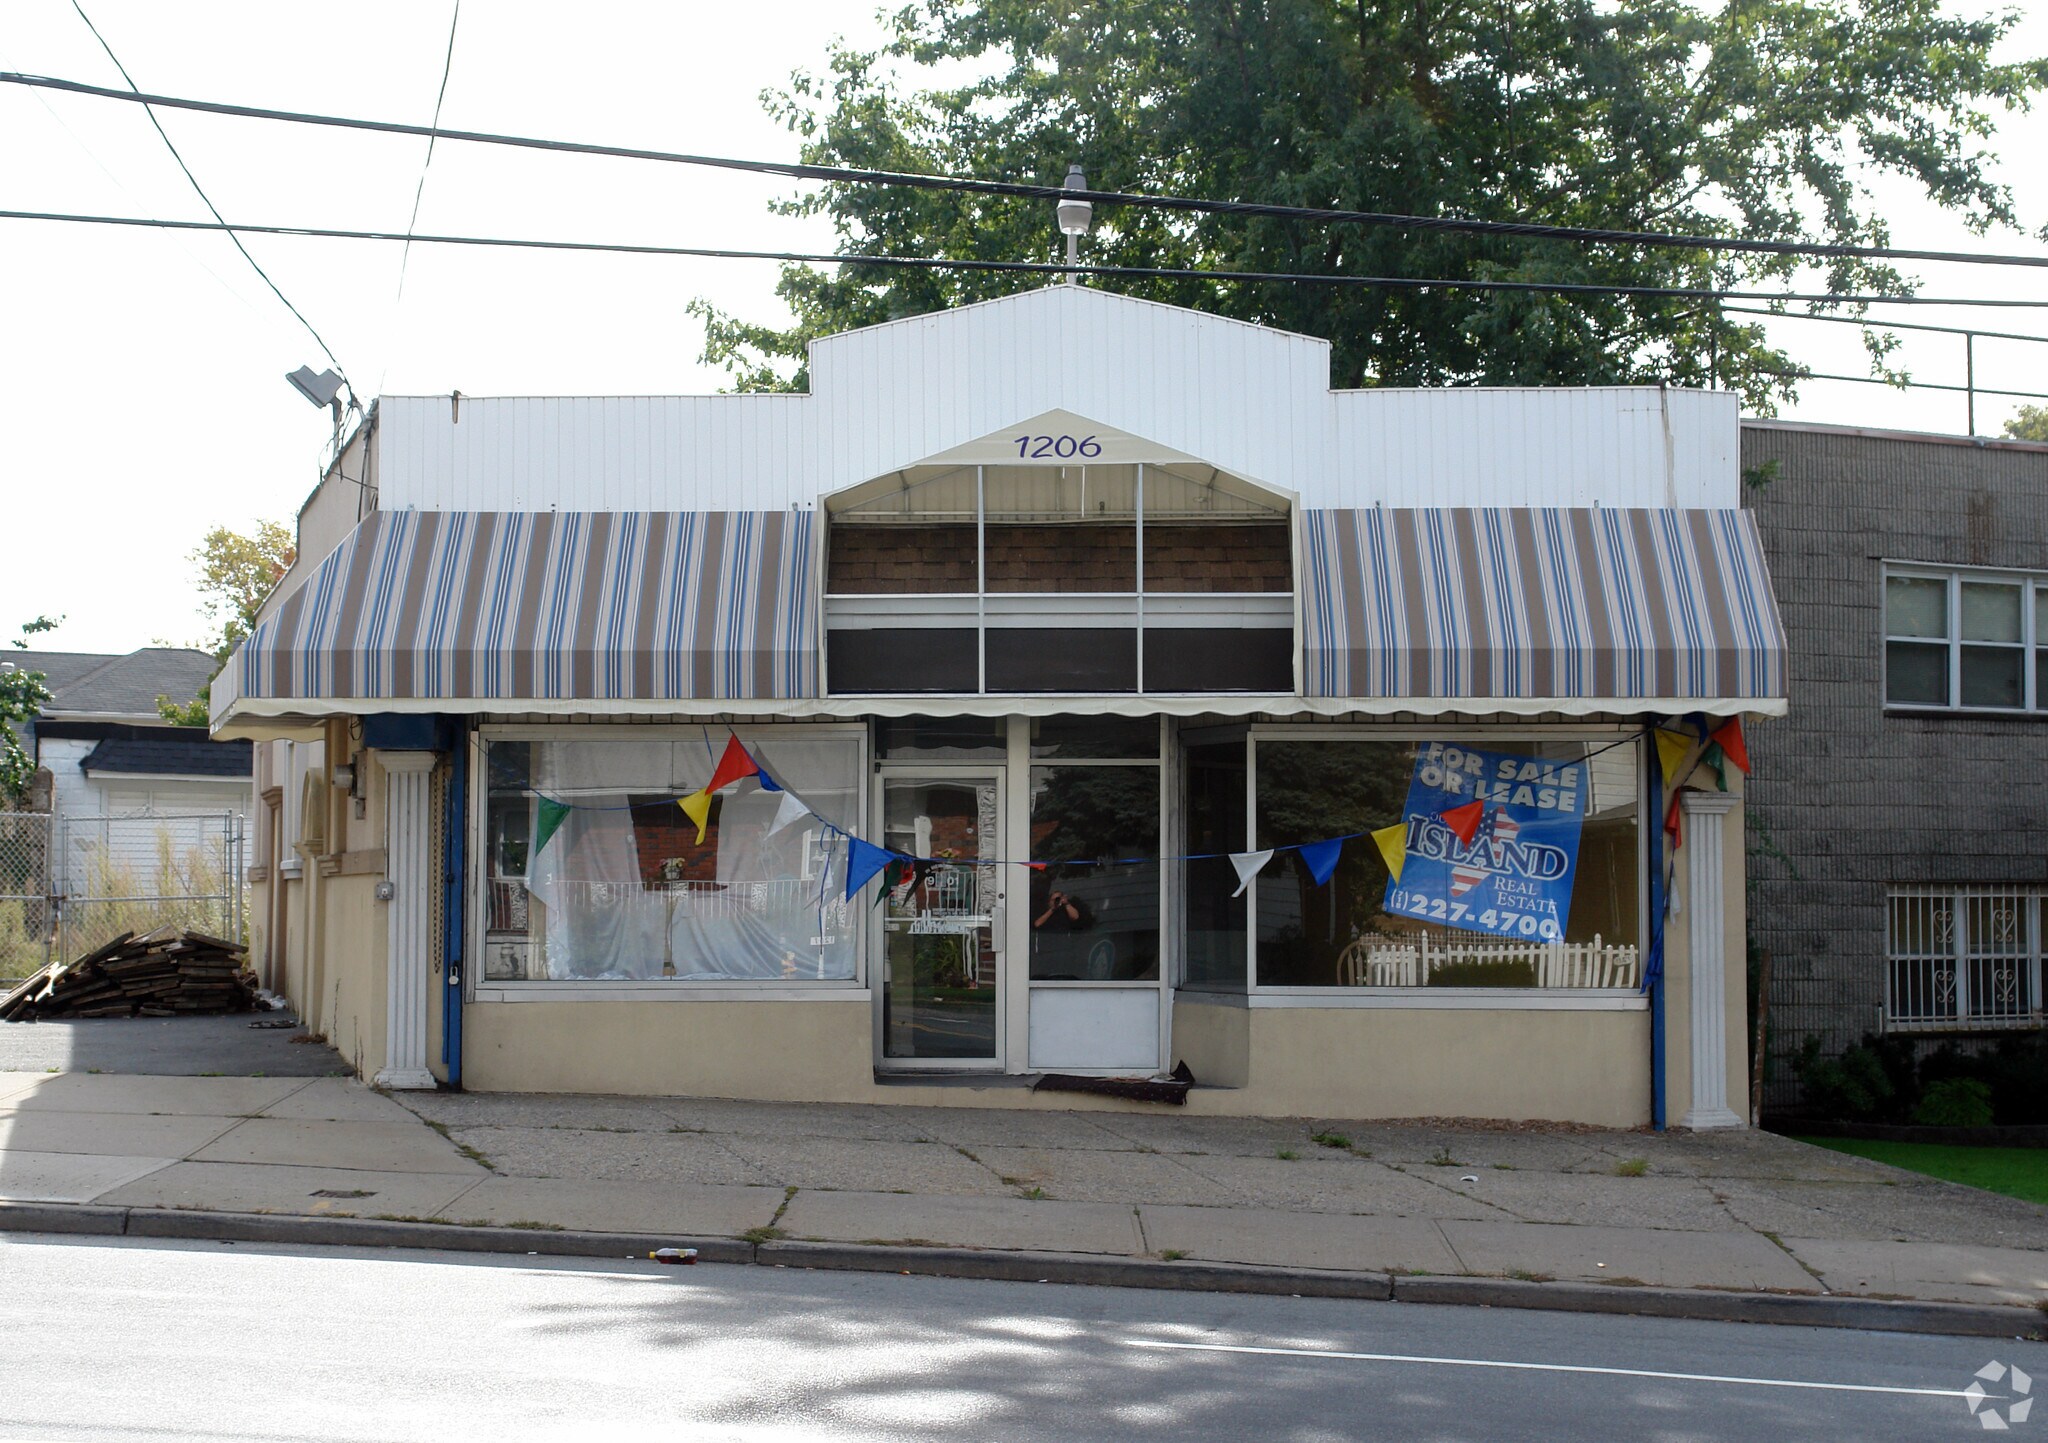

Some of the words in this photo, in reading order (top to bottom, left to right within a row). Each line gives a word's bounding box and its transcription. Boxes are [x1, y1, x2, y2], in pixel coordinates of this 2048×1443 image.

[1014, 435, 1102, 458] 1206
[1427, 742, 1484, 776] FOR
[1497, 759, 1579, 789] SALE
[1420, 766, 1463, 795] OR
[1475, 780, 1577, 812] LEASE
[1406, 813, 1569, 881] ISLAND
[1494, 876, 1537, 896] REAL
[1497, 891, 1557, 914] ESTATE
